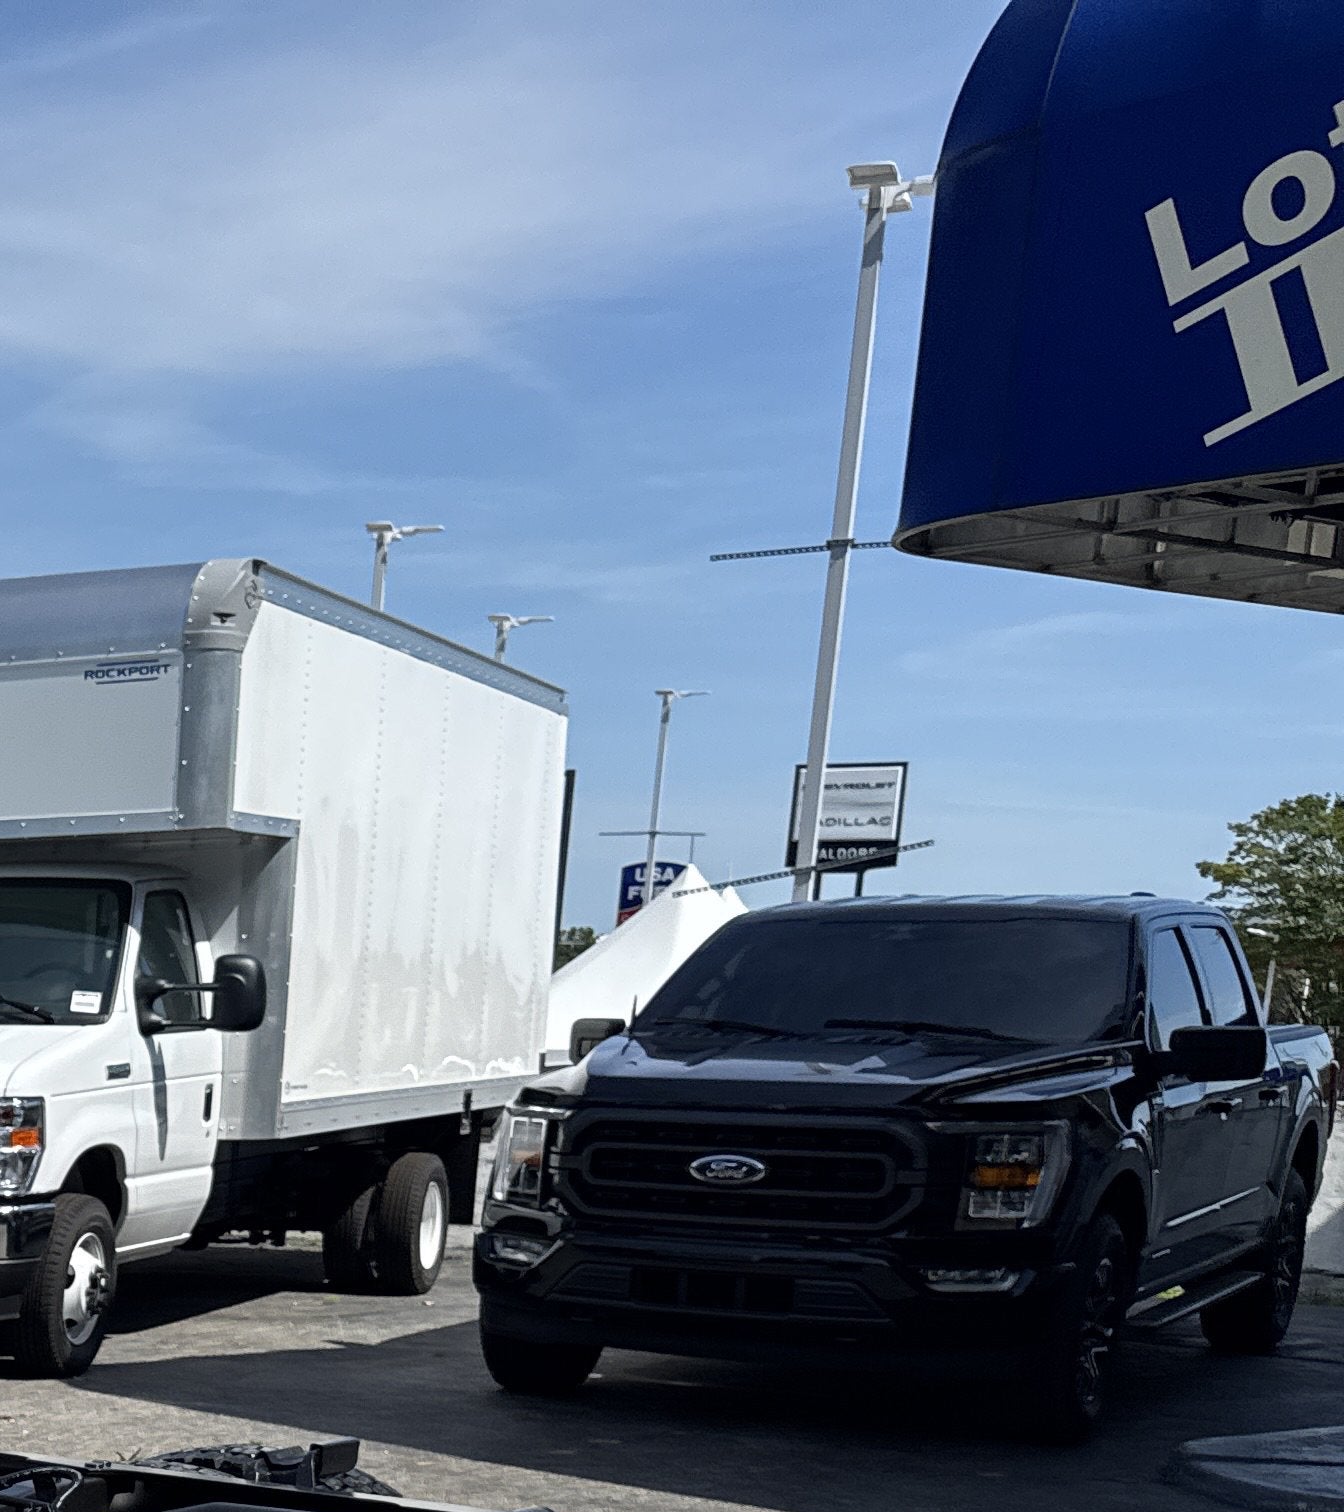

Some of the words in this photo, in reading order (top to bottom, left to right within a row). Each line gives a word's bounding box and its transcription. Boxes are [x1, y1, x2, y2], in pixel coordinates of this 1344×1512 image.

[84, 664, 171, 680] ROCKPORT
[823, 782, 895, 790] EVROLET
[705, 1161, 749, 1179] Ford
